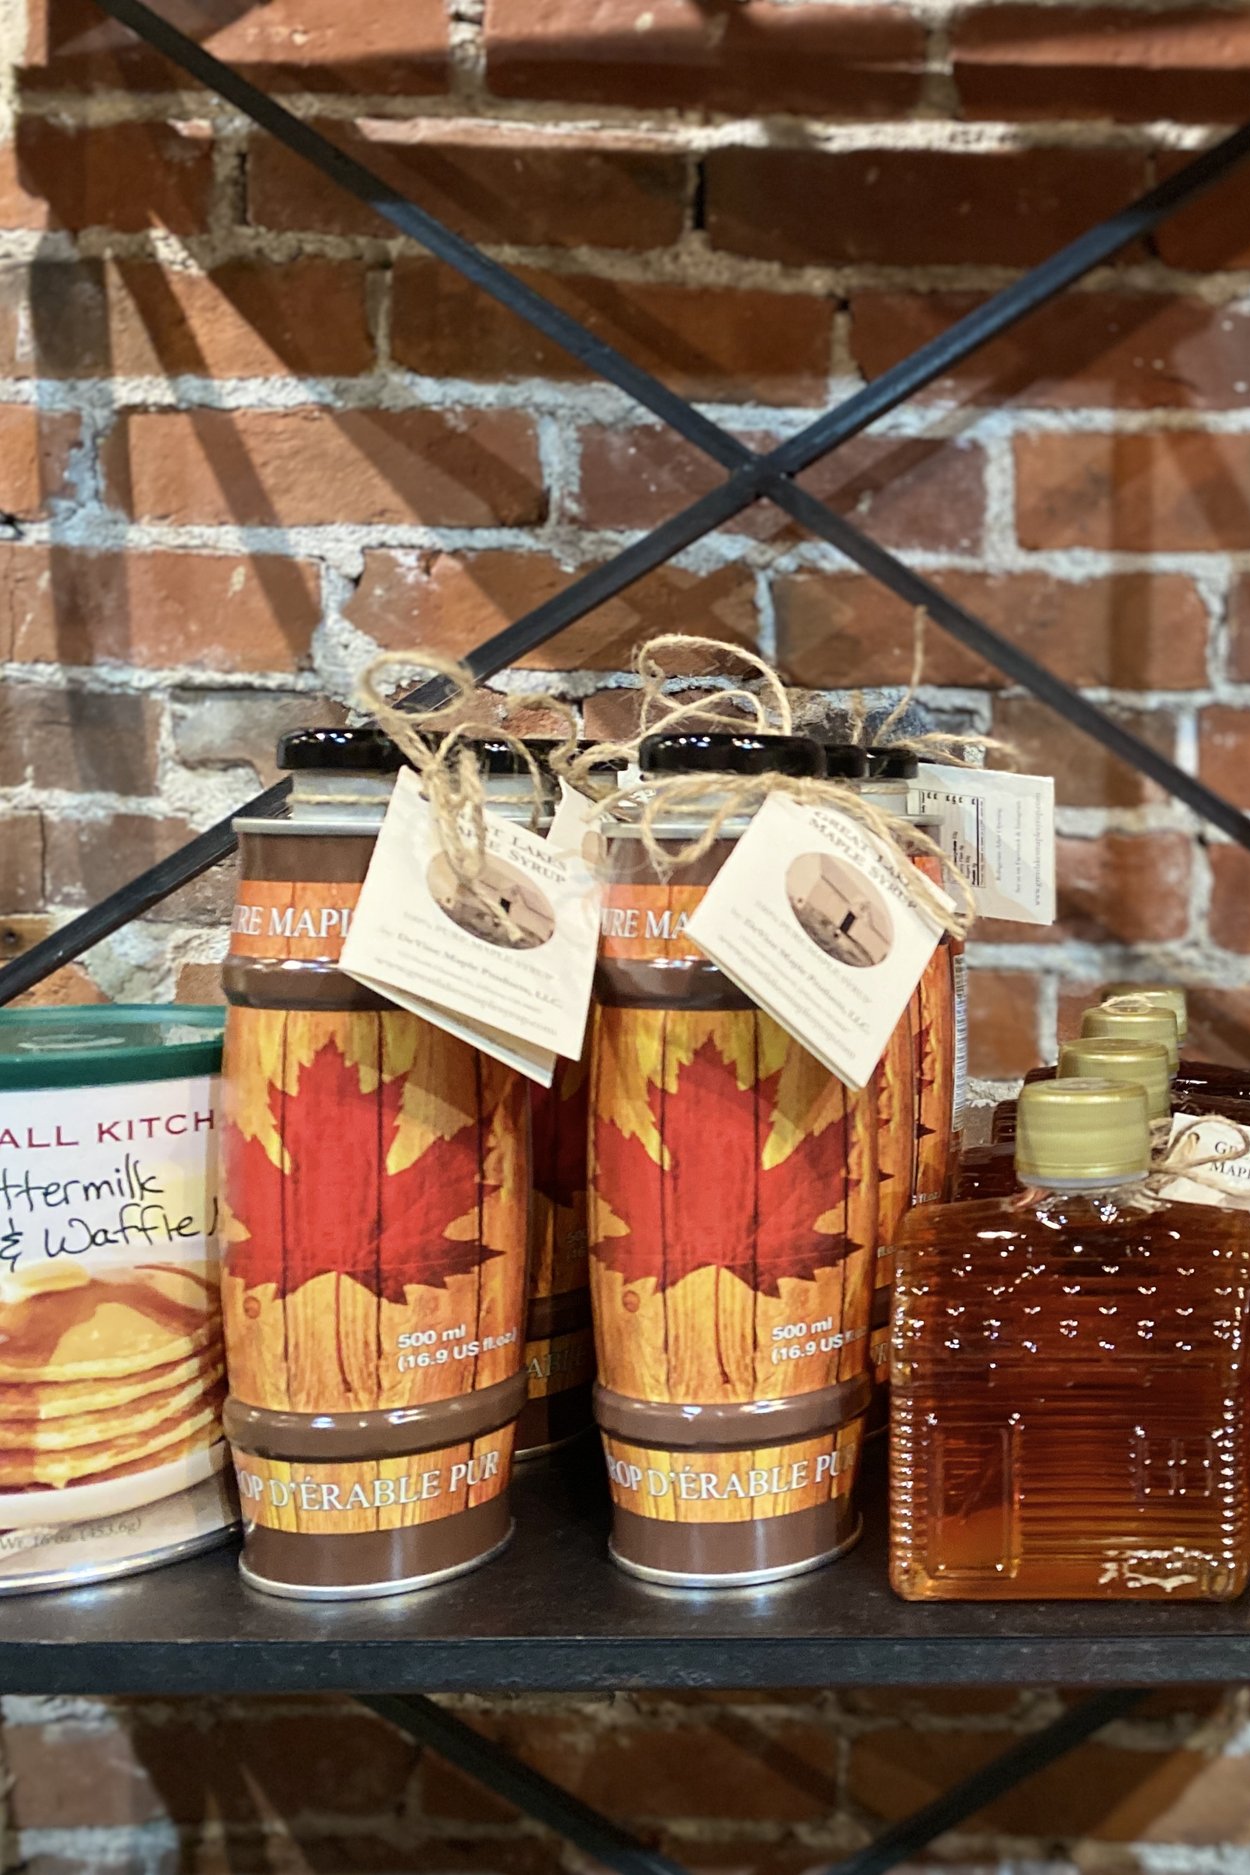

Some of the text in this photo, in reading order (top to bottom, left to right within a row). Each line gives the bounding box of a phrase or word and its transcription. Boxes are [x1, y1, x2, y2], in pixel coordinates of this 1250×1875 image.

[0, 1109, 215, 1149] ALL KITCH
[397, 1323, 467, 1349] 500 ml
[771, 1316, 833, 1341] 500 ml
[397, 1348, 449, 1373] (16.9
[452, 1340, 480, 1360] US
[771, 1341, 817, 1365] (16.9
[820, 1333, 843, 1352] US
[238, 1450, 500, 1511] OP D'ÉRABLE PUR
[648, 1463, 808, 1501] D'ÉRABLE
